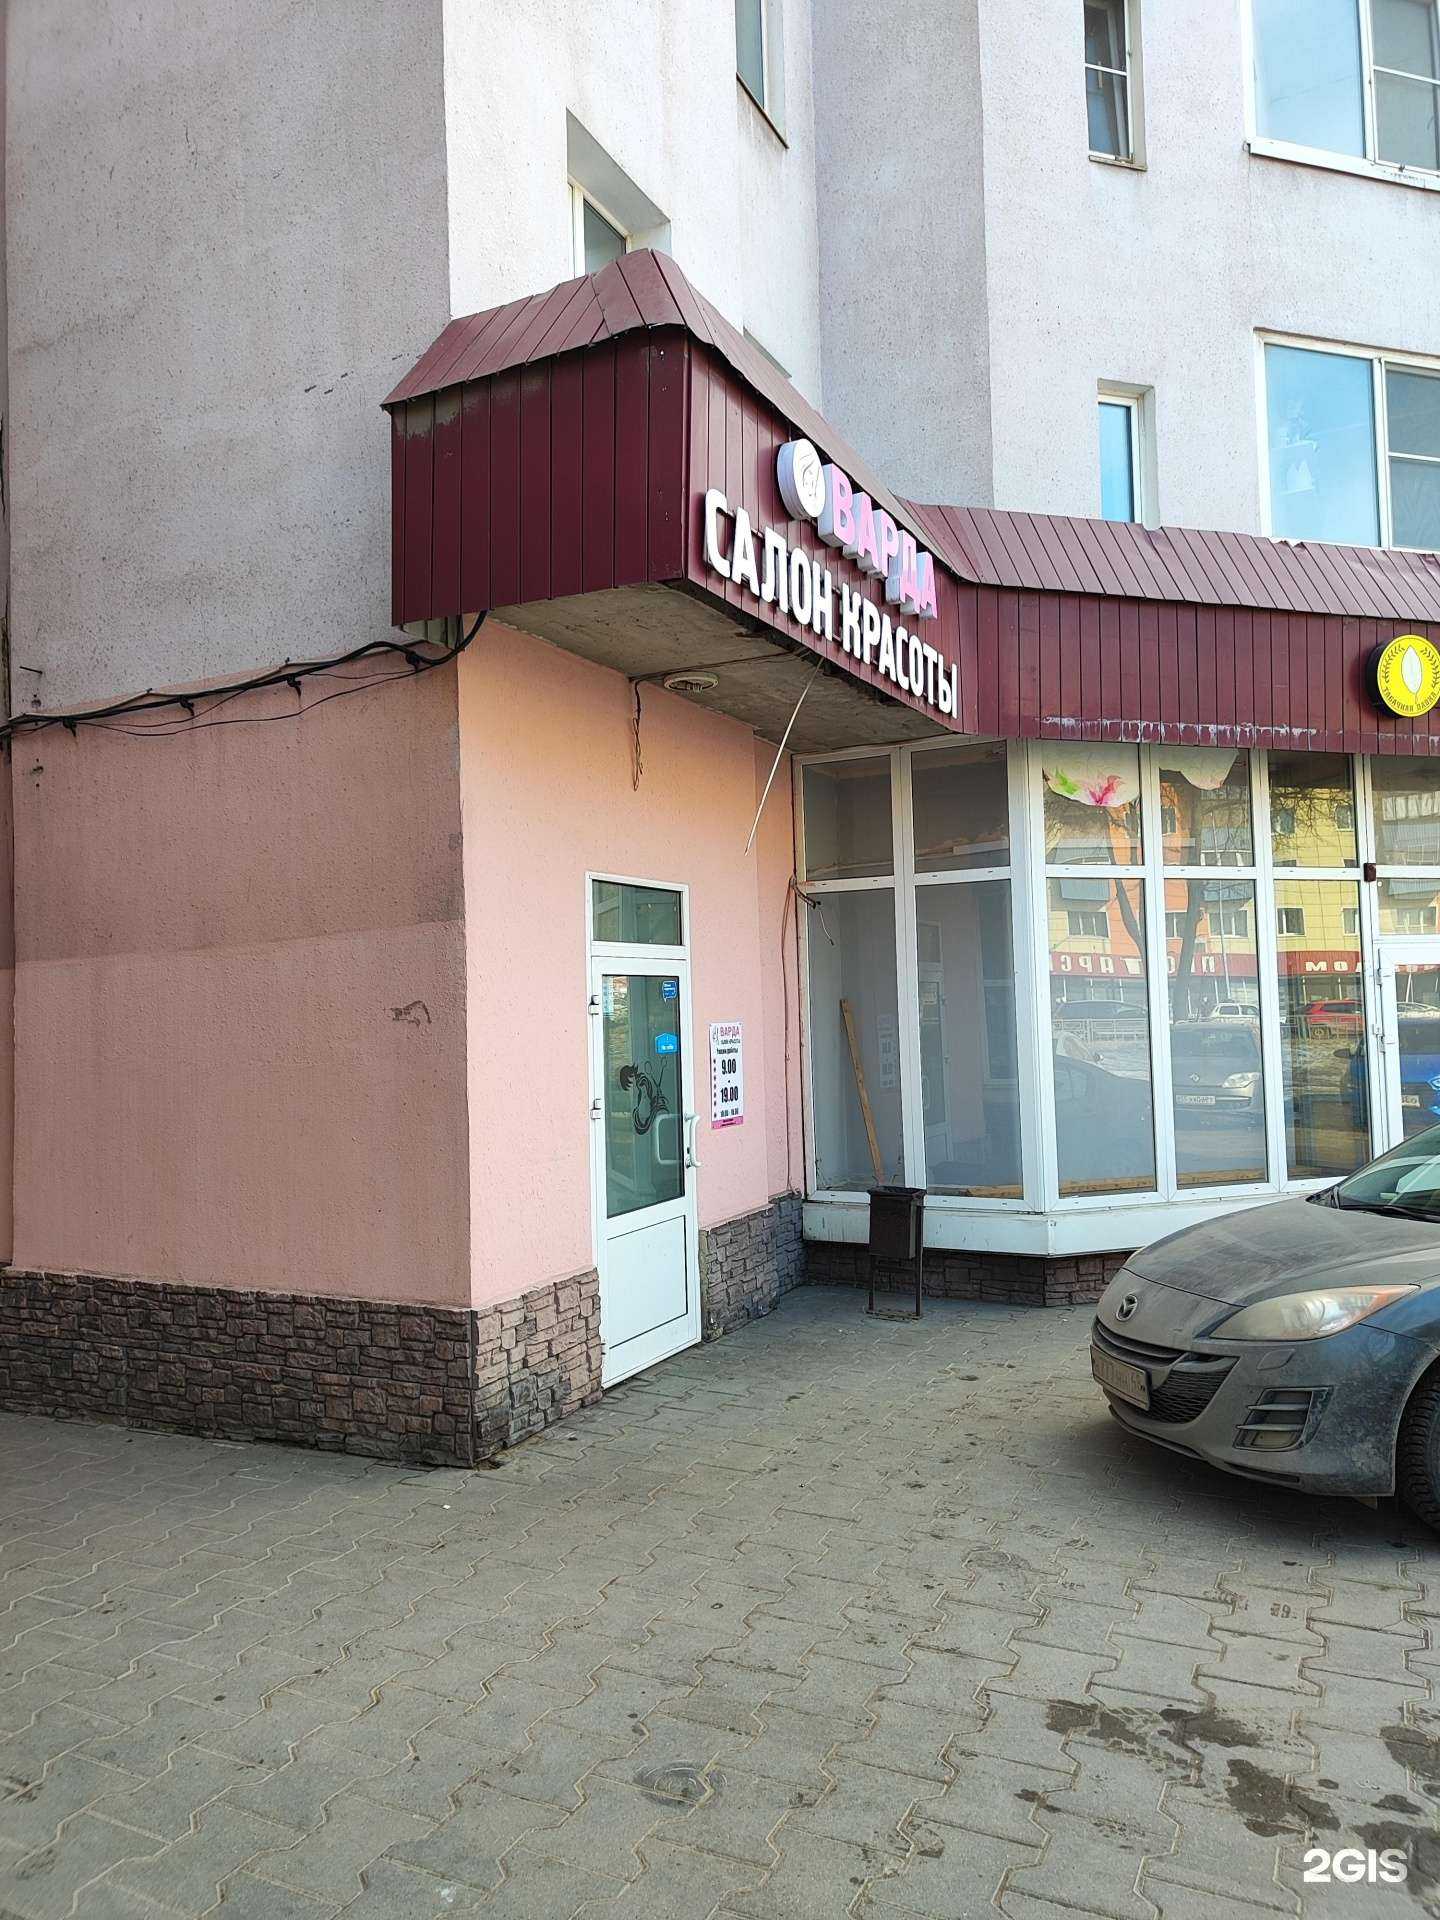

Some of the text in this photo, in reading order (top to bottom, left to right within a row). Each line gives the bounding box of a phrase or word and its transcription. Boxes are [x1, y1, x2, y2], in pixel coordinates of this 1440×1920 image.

[826, 463, 938, 619] ВАРДА
[704, 488, 958, 719] САЛОН КРАСОТЫ
[719, 1026, 740, 1039] ВАРДА
[721, 1058, 737, 1075] 9.00
[720, 1086, 739, 1103] 19.00
